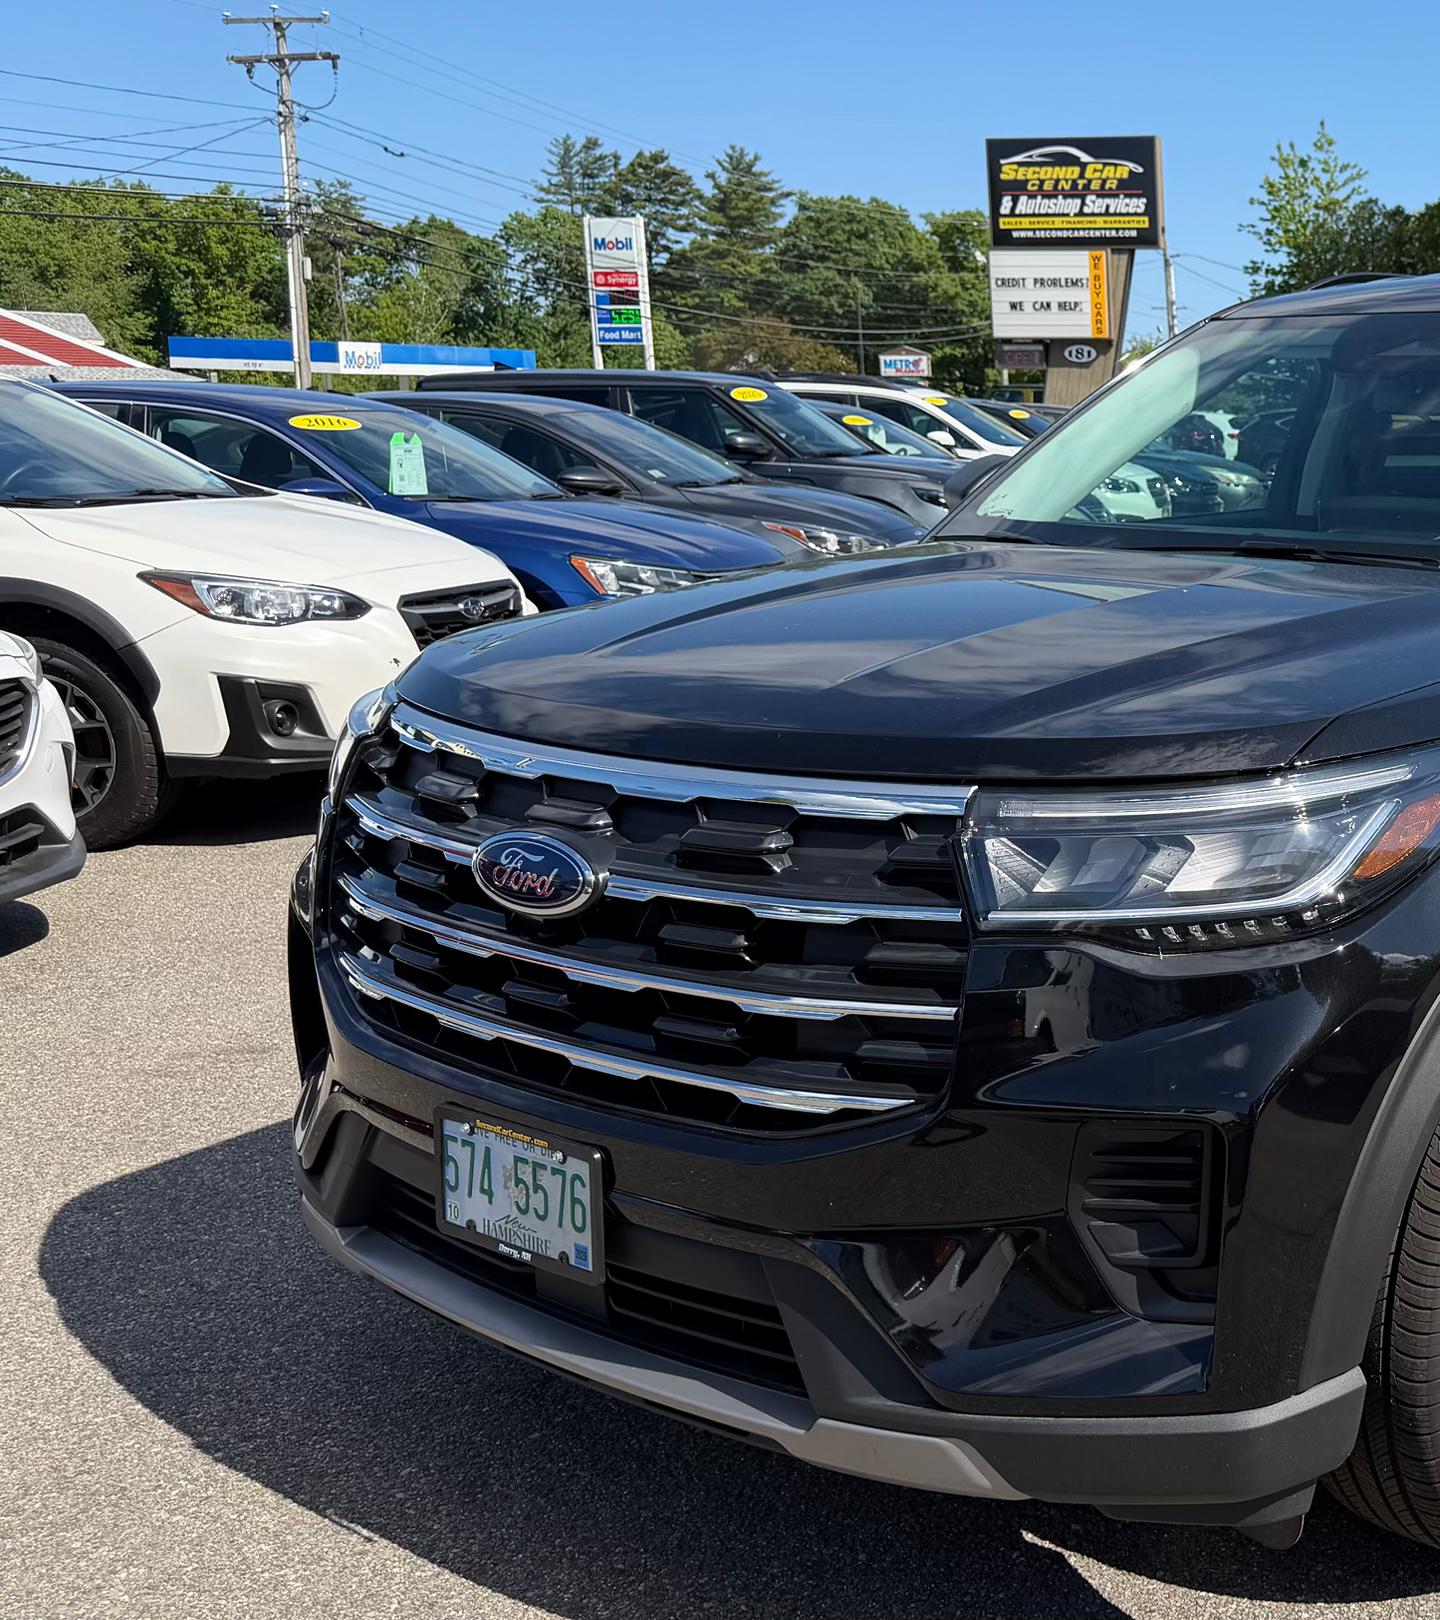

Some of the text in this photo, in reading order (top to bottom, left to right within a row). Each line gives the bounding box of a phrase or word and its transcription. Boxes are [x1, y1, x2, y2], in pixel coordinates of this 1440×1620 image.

[1000, 163, 1130, 180] SECOND CAR
[1026, 179, 1118, 191] CENTER
[1000, 194, 1147, 217] & Autoshop Services
[1011, 229, 1138, 238] WWW.SECONDCARCENTER.COM
[593, 237, 633, 251] Mobil
[1091, 255, 1102, 270] WE
[607, 275, 637, 285] Synergy
[995, 277, 1026, 288] CREDIT
[1094, 275, 1102, 298] BUY
[1009, 301, 1024, 312] WE
[1032, 301, 1051, 312] CAN
[1094, 302, 1103, 335] CARS
[599, 330, 642, 339] Food Mart
[345, 351, 381, 368] Mobil
[1069, 347, 1092, 360] 181
[303, 417, 348, 427] 2016
[492, 847, 560, 898] Ford
[475, 1119, 549, 1148] SecondCarCenter.com
[443, 1133, 587, 1234] 574 5576
[449, 1203, 459, 1219] 10
[494, 1213, 538, 1233] New
[482, 1217, 552, 1255] HAMPSHIRE
